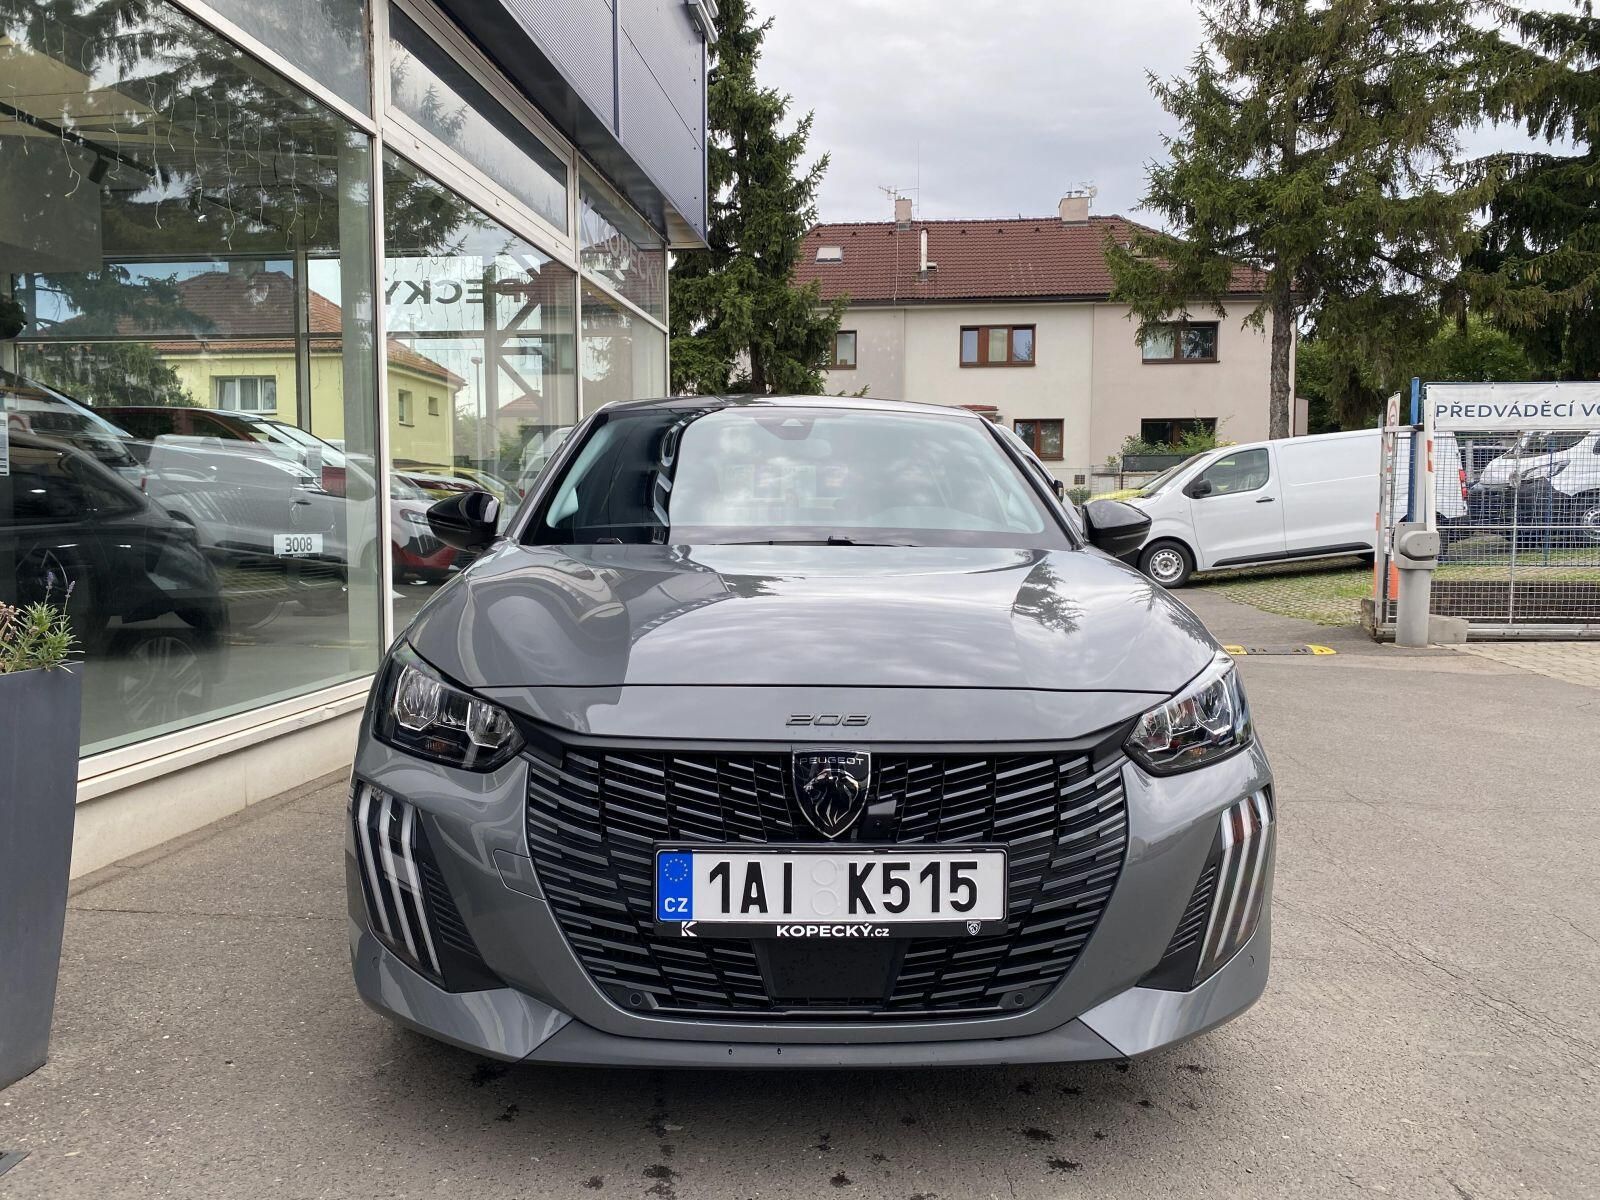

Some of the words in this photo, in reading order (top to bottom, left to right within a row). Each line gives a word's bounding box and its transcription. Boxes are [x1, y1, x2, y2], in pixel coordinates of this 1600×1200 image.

[1436, 400, 1575, 417] PŘEDVÁDĚCÍ
[285, 536, 313, 552] 3008
[786, 714, 871, 727] 208
[800, 756, 864, 765] PEUGEOT
[709, 861, 793, 914] 1AI
[848, 861, 978, 914] K515
[664, 897, 688, 913] CZ
[776, 922, 890, 937] KOPECKÝ.cz
